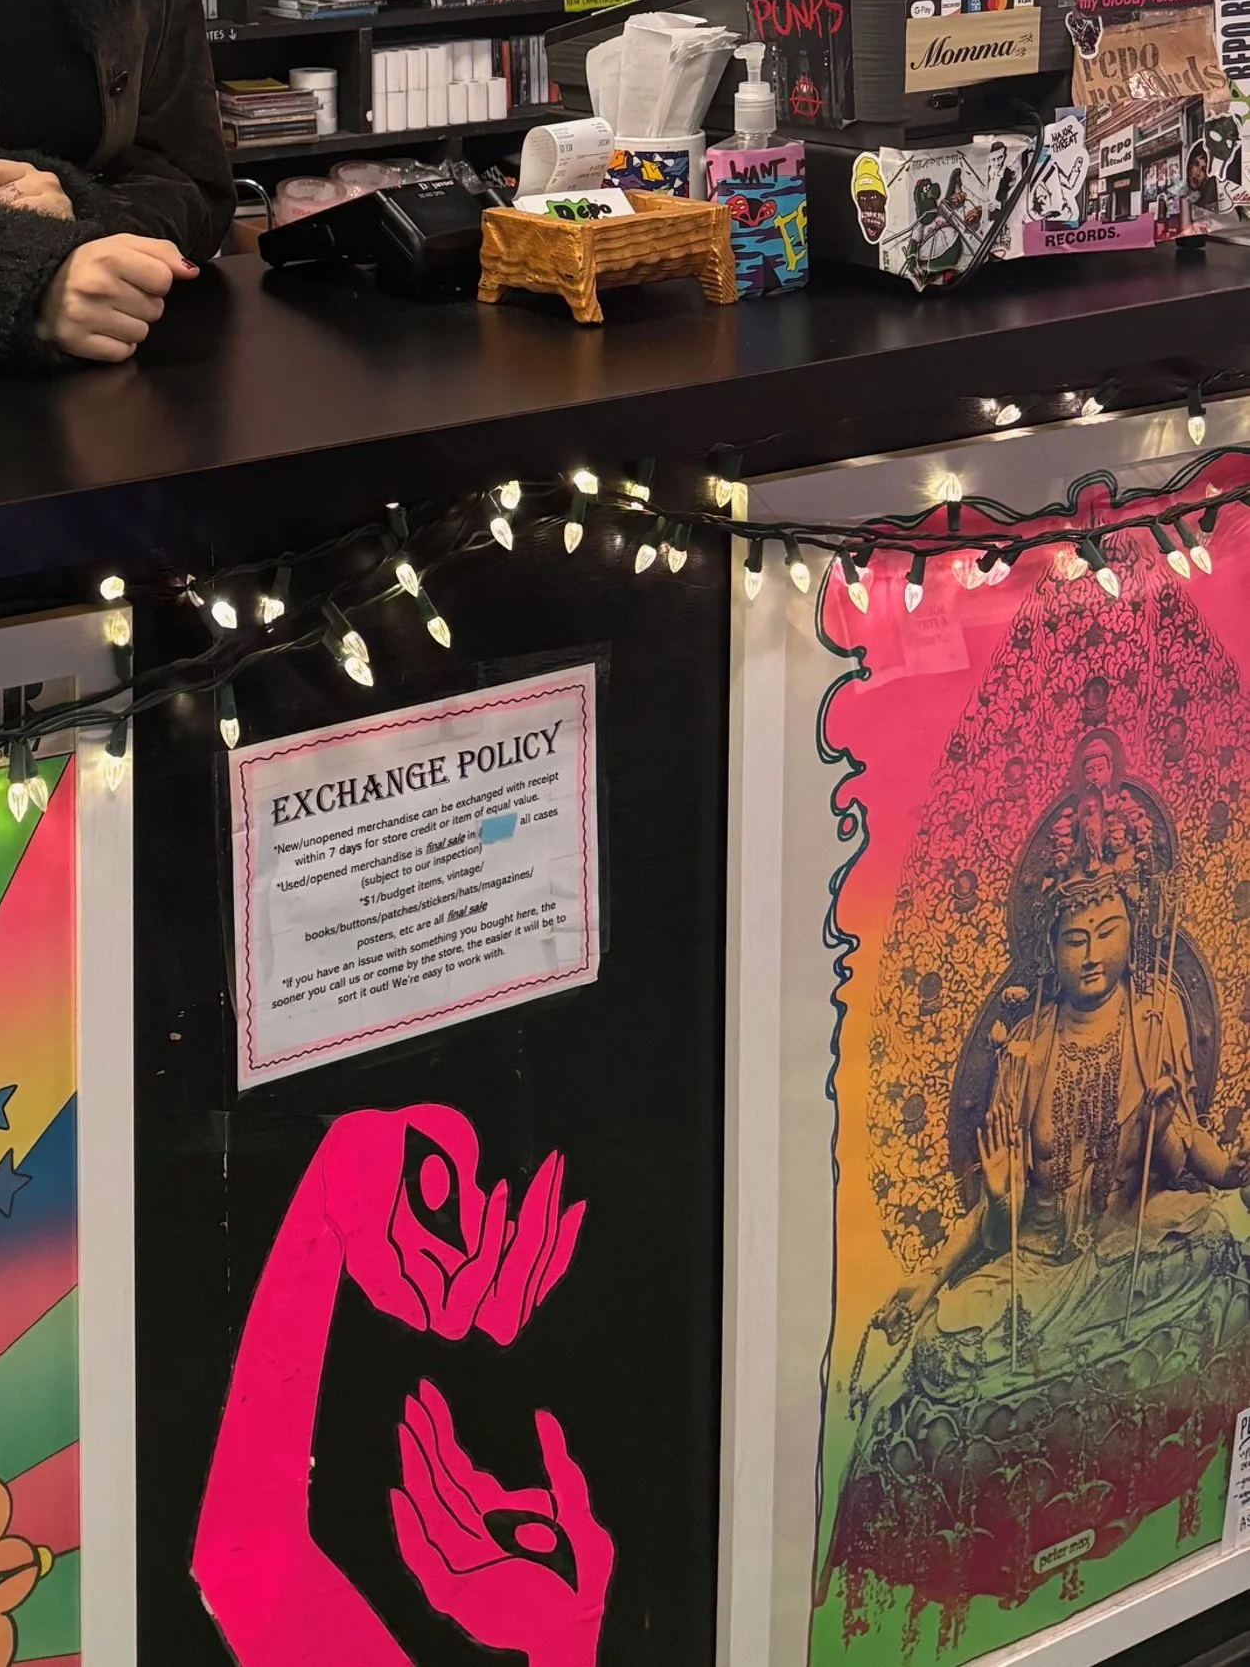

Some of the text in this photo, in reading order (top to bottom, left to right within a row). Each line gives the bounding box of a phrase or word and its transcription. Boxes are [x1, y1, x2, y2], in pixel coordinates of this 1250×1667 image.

[910, 35, 1014, 71] Momma
[1050, 124, 1074, 143] MAJOR
[1051, 132, 1079, 154] THREAT
[1100, 135, 1132, 169] Repo
[730, 157, 786, 184] WANT
[1045, 227, 1121, 247] RECORDS.
[271, 720, 563, 827] EXCHANGE POLICY
[356, 812, 420, 835] merchandise
[421, 807, 439, 819] can
[441, 803, 454, 813] be
[455, 785, 504, 809] exchanged
[505, 780, 526, 794] with
[527, 771, 559, 788] receipt
[294, 793, 540, 867] within 7 days for store credit or item of equal value.
[350, 850, 413, 874] merchandise
[415, 846, 423, 857] is
[425, 837, 446, 855] final
[446, 832, 466, 849] sale
[466, 830, 476, 840] in
[519, 813, 531, 825] all
[533, 808, 559, 822] cases
[360, 842, 483, 890] (subject to our inspection)
[417, 876, 445, 892] items,
[446, 860, 485, 882] vintage/
[304, 866, 534, 942] books/buttons/patches/stickers/hats/magazines/
[356, 900, 489, 951] posters, etc are all final sale
[1038, 1536, 1091, 1572] peter max
